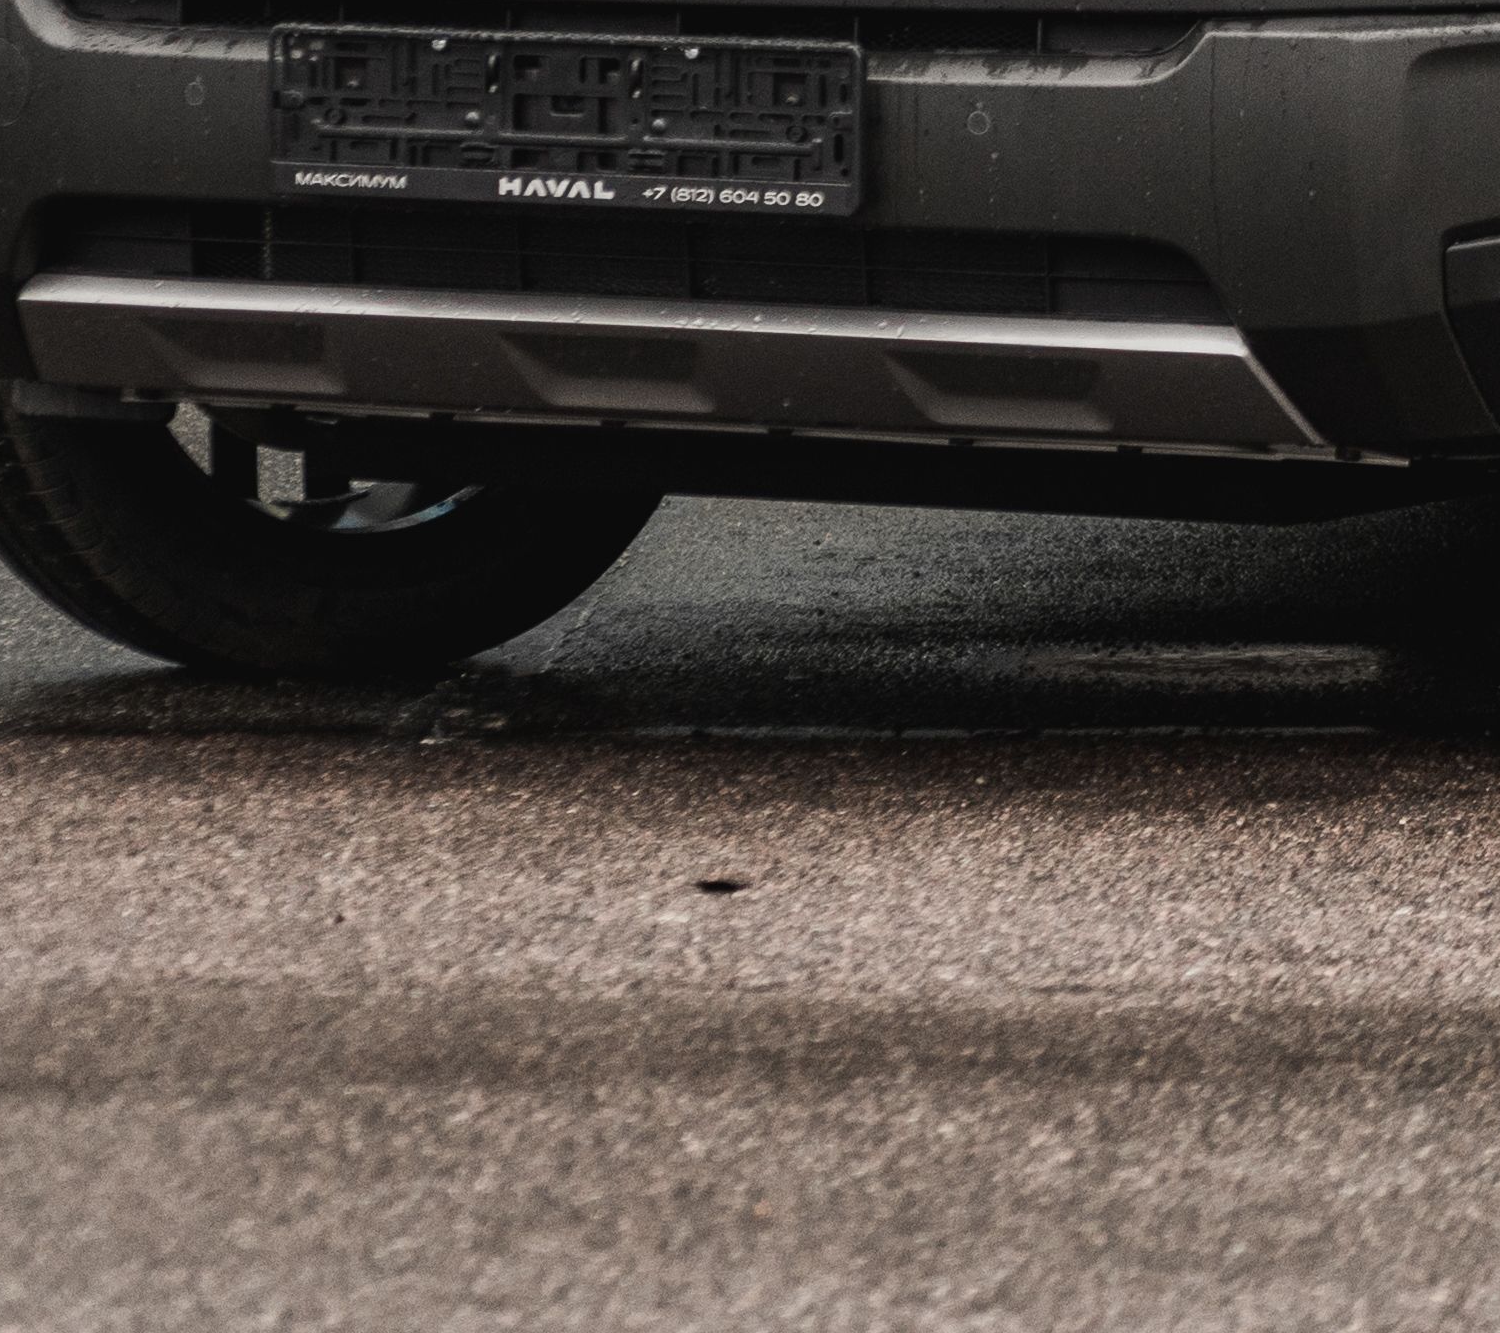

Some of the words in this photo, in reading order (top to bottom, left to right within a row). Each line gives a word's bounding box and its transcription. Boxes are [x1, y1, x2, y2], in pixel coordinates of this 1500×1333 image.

[294, 171, 409, 189] МАКСИМУМ
[498, 176, 616, 201] HAVAL
[641, 186, 668, 201] +7
[670, 186, 715, 205] (812)
[719, 187, 760, 205] 604
[763, 190, 792, 207] 50
[794, 191, 825, 208] 80
